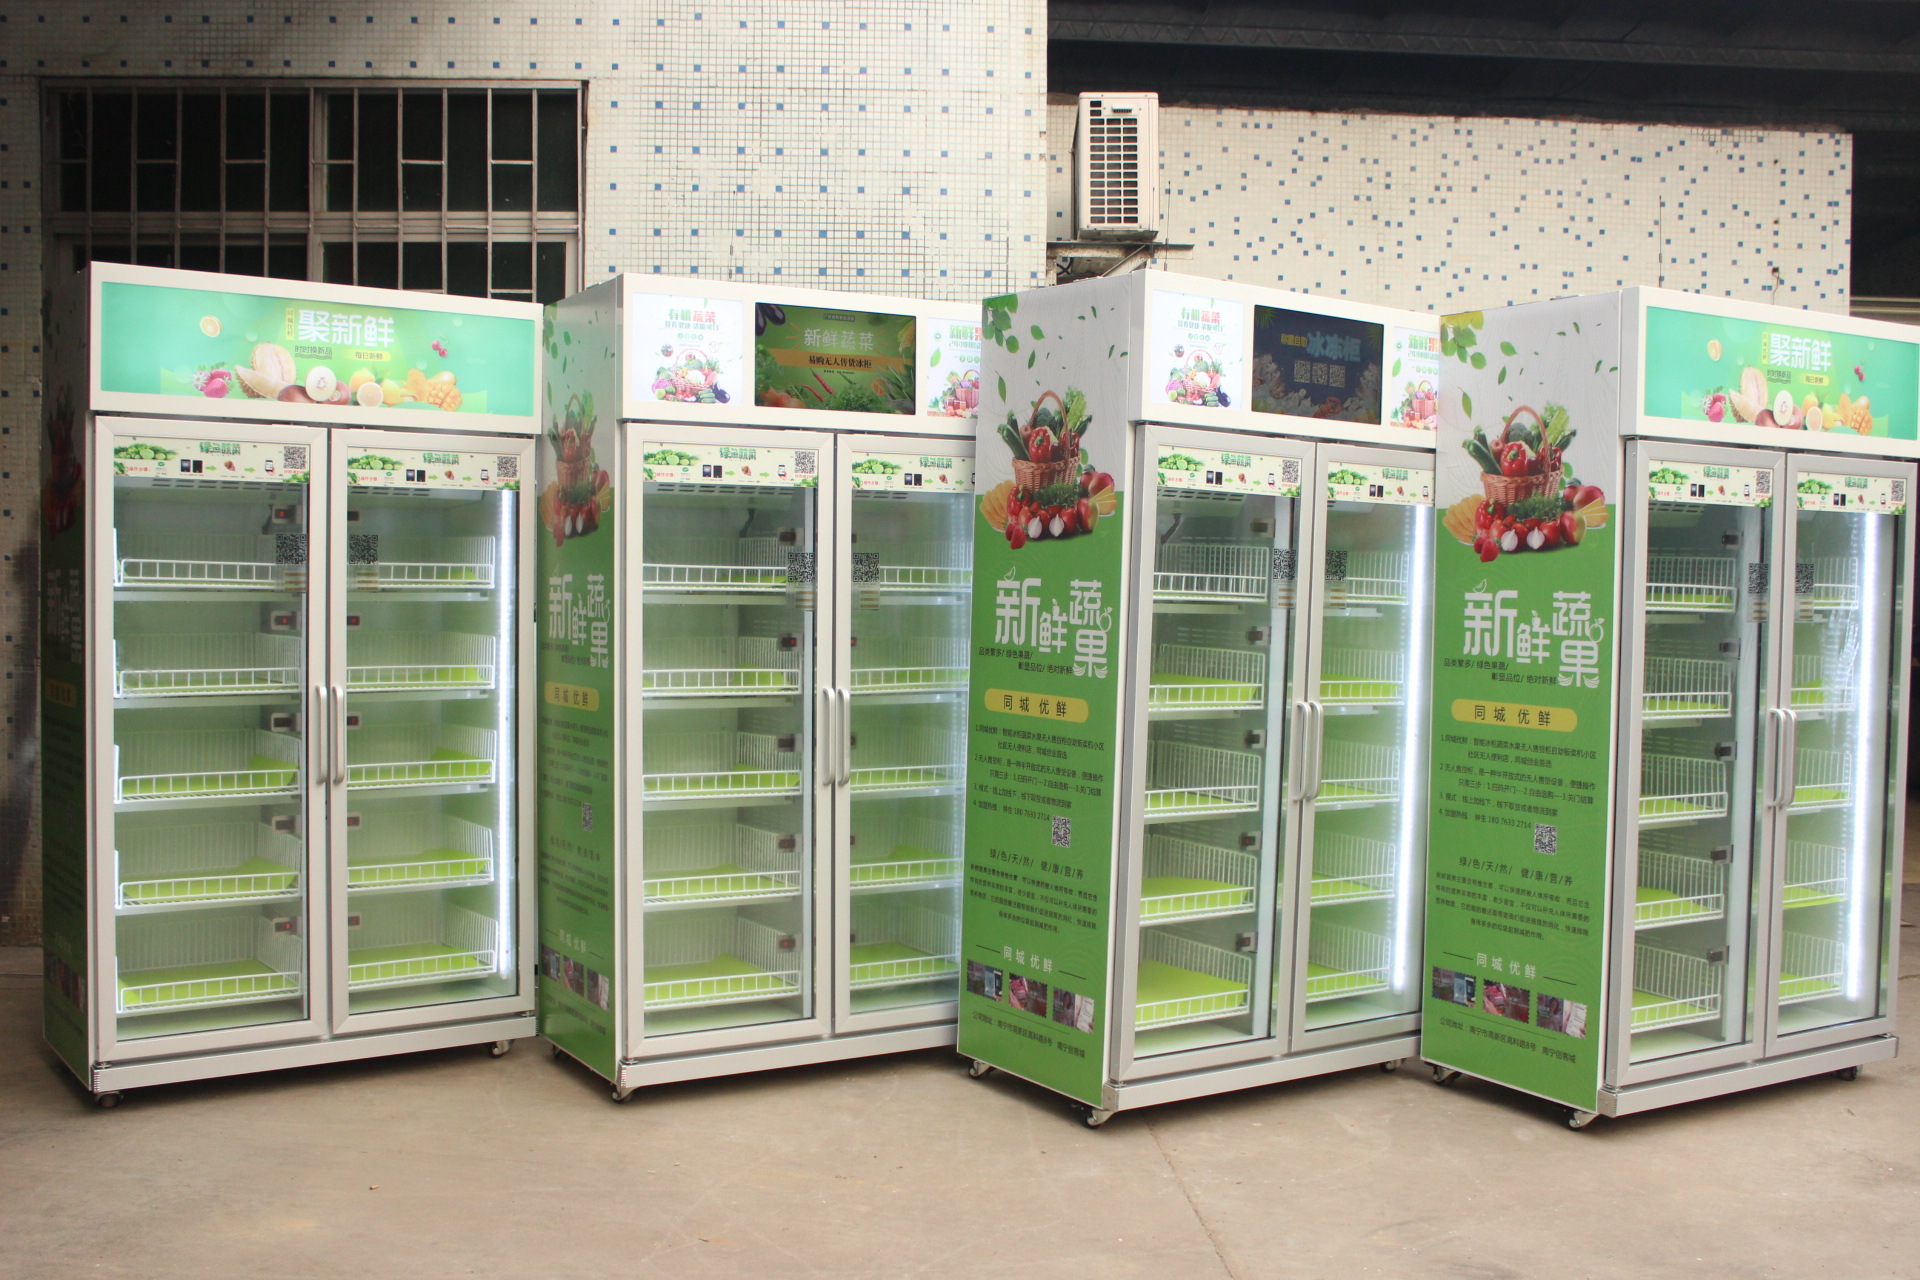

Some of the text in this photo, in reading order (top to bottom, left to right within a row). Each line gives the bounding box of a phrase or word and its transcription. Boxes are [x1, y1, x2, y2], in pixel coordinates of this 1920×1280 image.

[298, 309, 395, 348] 聚新鲜
[804, 327, 874, 351] 新鲜蔬菜
[294, 345, 333, 356] 时时换新品
[354, 351, 384, 360] 每日新鲜
[1769, 332, 1832, 372] 聚新鲜
[1526, 673, 1557, 686] 绝对新鲜
[1003, 693, 1067, 718] 同城优鲜
[1474, 704, 1551, 727] 同城优鲜
[1500, 818, 1515, 827] 7633
[1516, 820, 1531, 829] 2714
[1003, 946, 1053, 974] 同城优鲜
[1476, 952, 1537, 979] 同城优鲜
